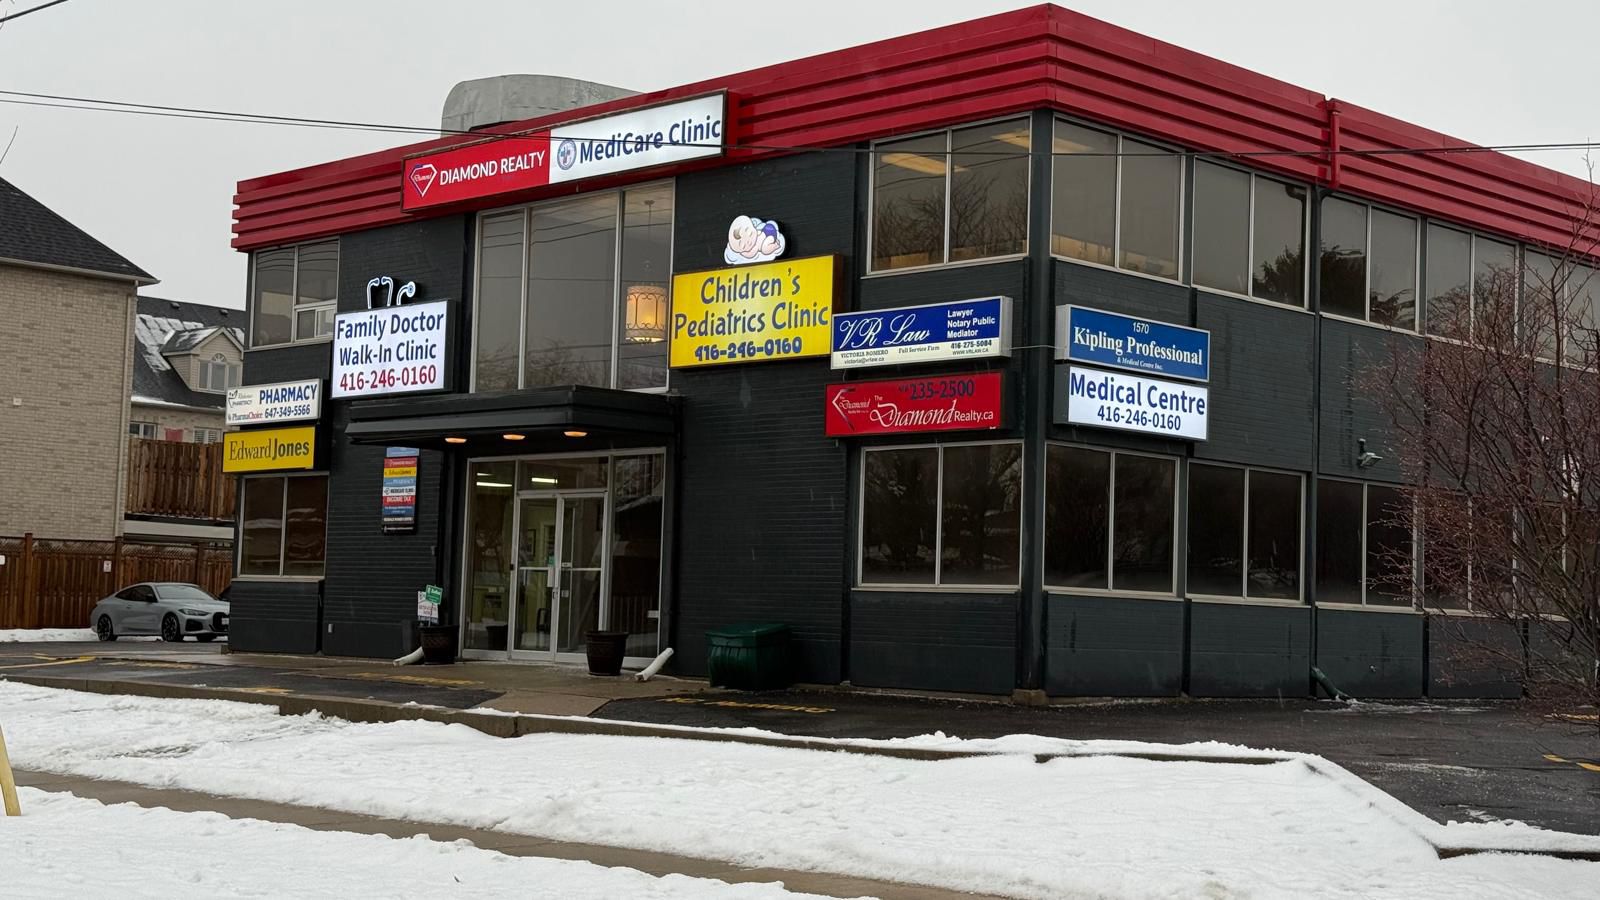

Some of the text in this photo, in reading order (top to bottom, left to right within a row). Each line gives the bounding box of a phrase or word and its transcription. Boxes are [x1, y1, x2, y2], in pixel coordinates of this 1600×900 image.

[580, 115, 721, 164] MediCare Clinic
[439, 150, 545, 186] DIAMOND REALTY
[701, 267, 801, 304] Children's
[337, 311, 444, 341] Family Doctor
[674, 302, 829, 339] Pediatrics Clinic
[947, 308, 974, 318] Lawyer
[947, 316, 996, 329] Notary Public
[839, 313, 930, 349] VR Law
[946, 329, 978, 338] Mediator
[1132, 322, 1150, 335] 1570
[339, 338, 437, 366] Walk-In Clinic
[694, 336, 803, 361] 416-246-0160
[840, 349, 889, 358] VICTORIA ROMERO
[1073, 326, 1203, 366] Kipling Professional
[1122, 357, 1139, 367] Medical
[340, 364, 437, 391] 416-246-0160
[910, 379, 976, 400] 235-2500
[259, 384, 318, 405] PHARMACY
[1070, 372, 1206, 415] Medical Centre
[264, 404, 311, 419] 647-349-5566
[1097, 405, 1181, 431] 416-246-0160
